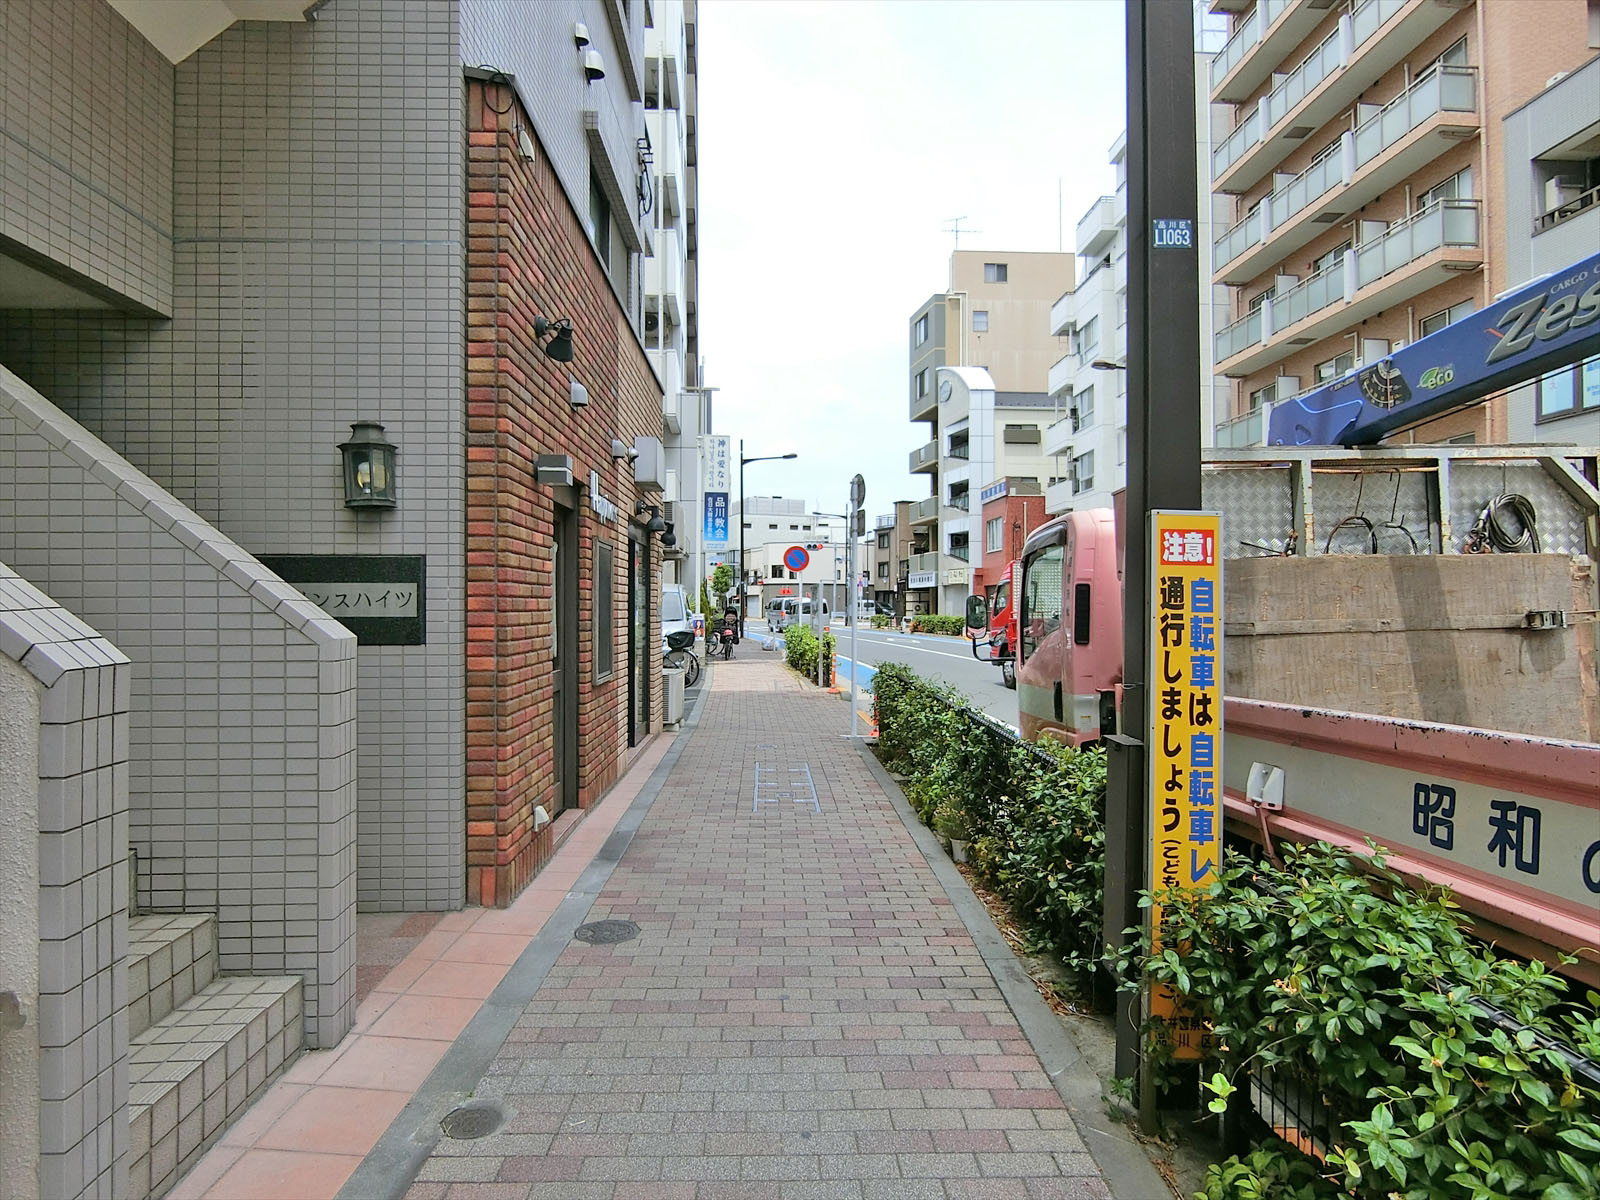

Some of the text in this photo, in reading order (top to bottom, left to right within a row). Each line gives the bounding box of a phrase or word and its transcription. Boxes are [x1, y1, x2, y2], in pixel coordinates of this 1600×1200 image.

[1158, 221, 1187, 229] 品川区
[1550, 271, 1588, 294] CARGO
[1428, 369, 1455, 390] eco
[717, 439, 726, 488] 神は愛なり
[715, 497, 725, 538] 品川教会
[302, 590, 413, 609] ンスハイツ
